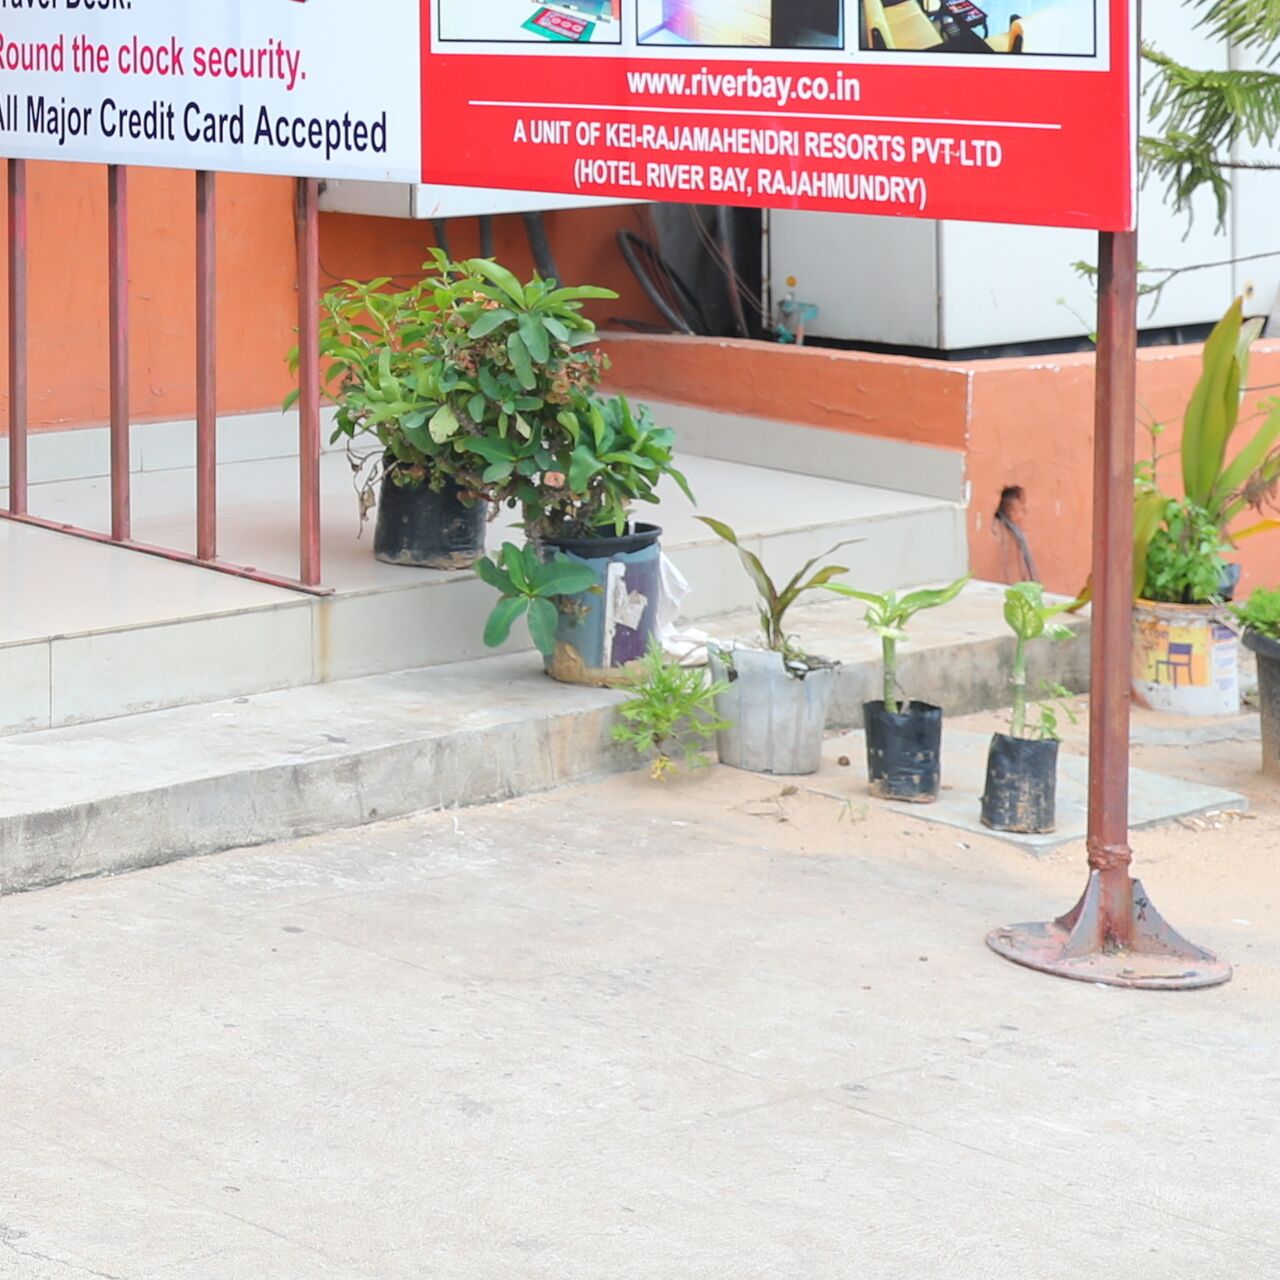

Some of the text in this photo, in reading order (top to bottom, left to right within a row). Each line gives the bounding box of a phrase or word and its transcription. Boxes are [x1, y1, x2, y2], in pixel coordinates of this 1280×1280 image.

[72, 35, 109, 73] the
[118, 36, 184, 76] clock
[193, 39, 306, 91] security.
[627, 67, 861, 106] www.riverbay.co.in
[26, 96, 92, 146] Major
[99, 98, 174, 141] Credit
[183, 101, 245, 145] Card
[253, 106, 388, 160] Accepted
[513, 119, 527, 143] A
[530, 119, 571, 145] UNIT
[576, 122, 601, 147] OF
[606, 123, 800, 156] KEI-RAJAMAHENDRI
[805, 131, 905, 163] RESORTS
[574, 158, 927, 211] (HOTEL RIVER BAY, RAJAHMUNDRY)
